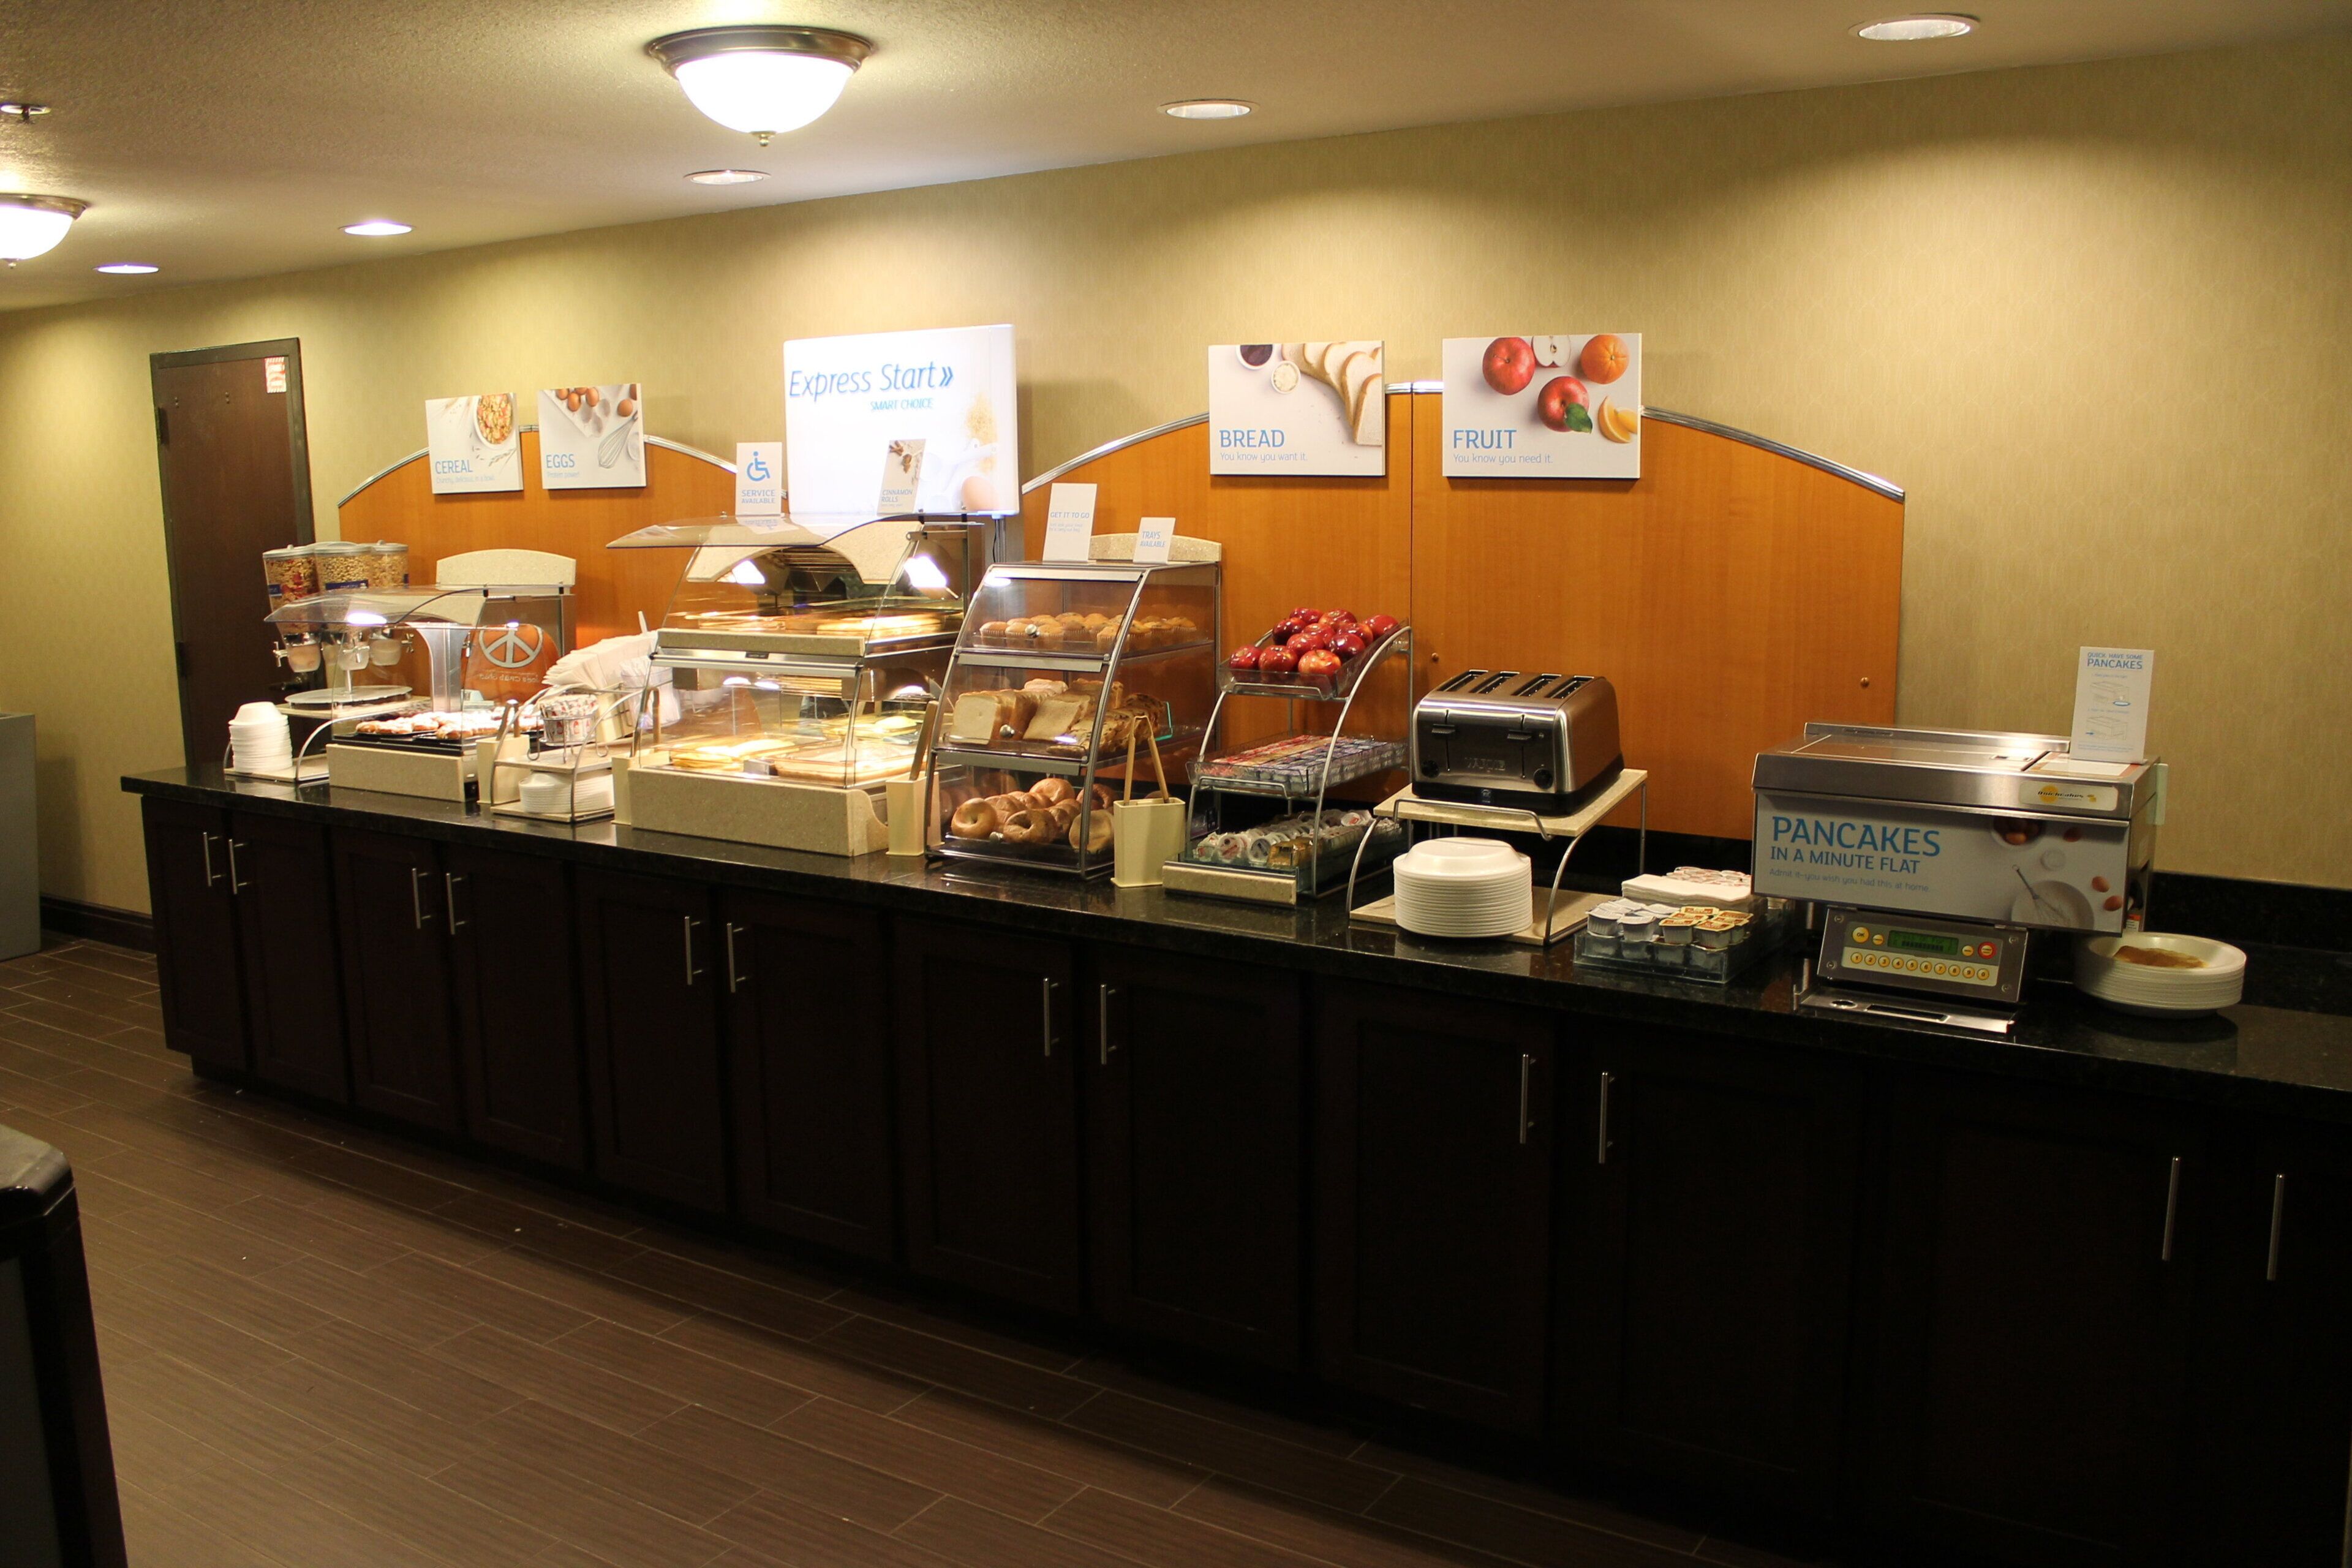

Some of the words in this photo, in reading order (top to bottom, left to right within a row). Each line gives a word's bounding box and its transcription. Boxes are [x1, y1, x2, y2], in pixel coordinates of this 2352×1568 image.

[790, 370, 872, 402] Express
[880, 361, 936, 391] Start
[870, 400, 897, 411] SMART
[901, 398, 933, 409] CHOICE
[1219, 429, 1285, 448] BREAD
[1453, 429, 1517, 449] FRUIT
[546, 453, 575, 469] EGGS
[1237, 452, 1258, 461] know
[1260, 454, 1275, 463] you
[1300, 453, 1308, 461] it.
[1453, 454, 1469, 463] You
[1472, 454, 1496, 463] know
[1499, 455, 1516, 466] you
[1519, 454, 1542, 464] need
[1545, 454, 1553, 464] it.
[435, 460, 473, 474] CEREAL
[1142, 530, 1161, 539] TRAYS
[2087, 658, 2143, 670] PANCAKES
[1772, 816, 1941, 858] PANCAKES
[1771, 846, 1788, 861] IN
[1793, 848, 1804, 862] A
[1809, 850, 1875, 870] MINUTE
[1880, 856, 1921, 874] FLAT
[1769, 868, 1793, 878] Admit
[1822, 874, 1841, 883] wish
[1842, 876, 1858, 886] you
[1860, 878, 1875, 887] had
[1877, 879, 1892, 889] this
